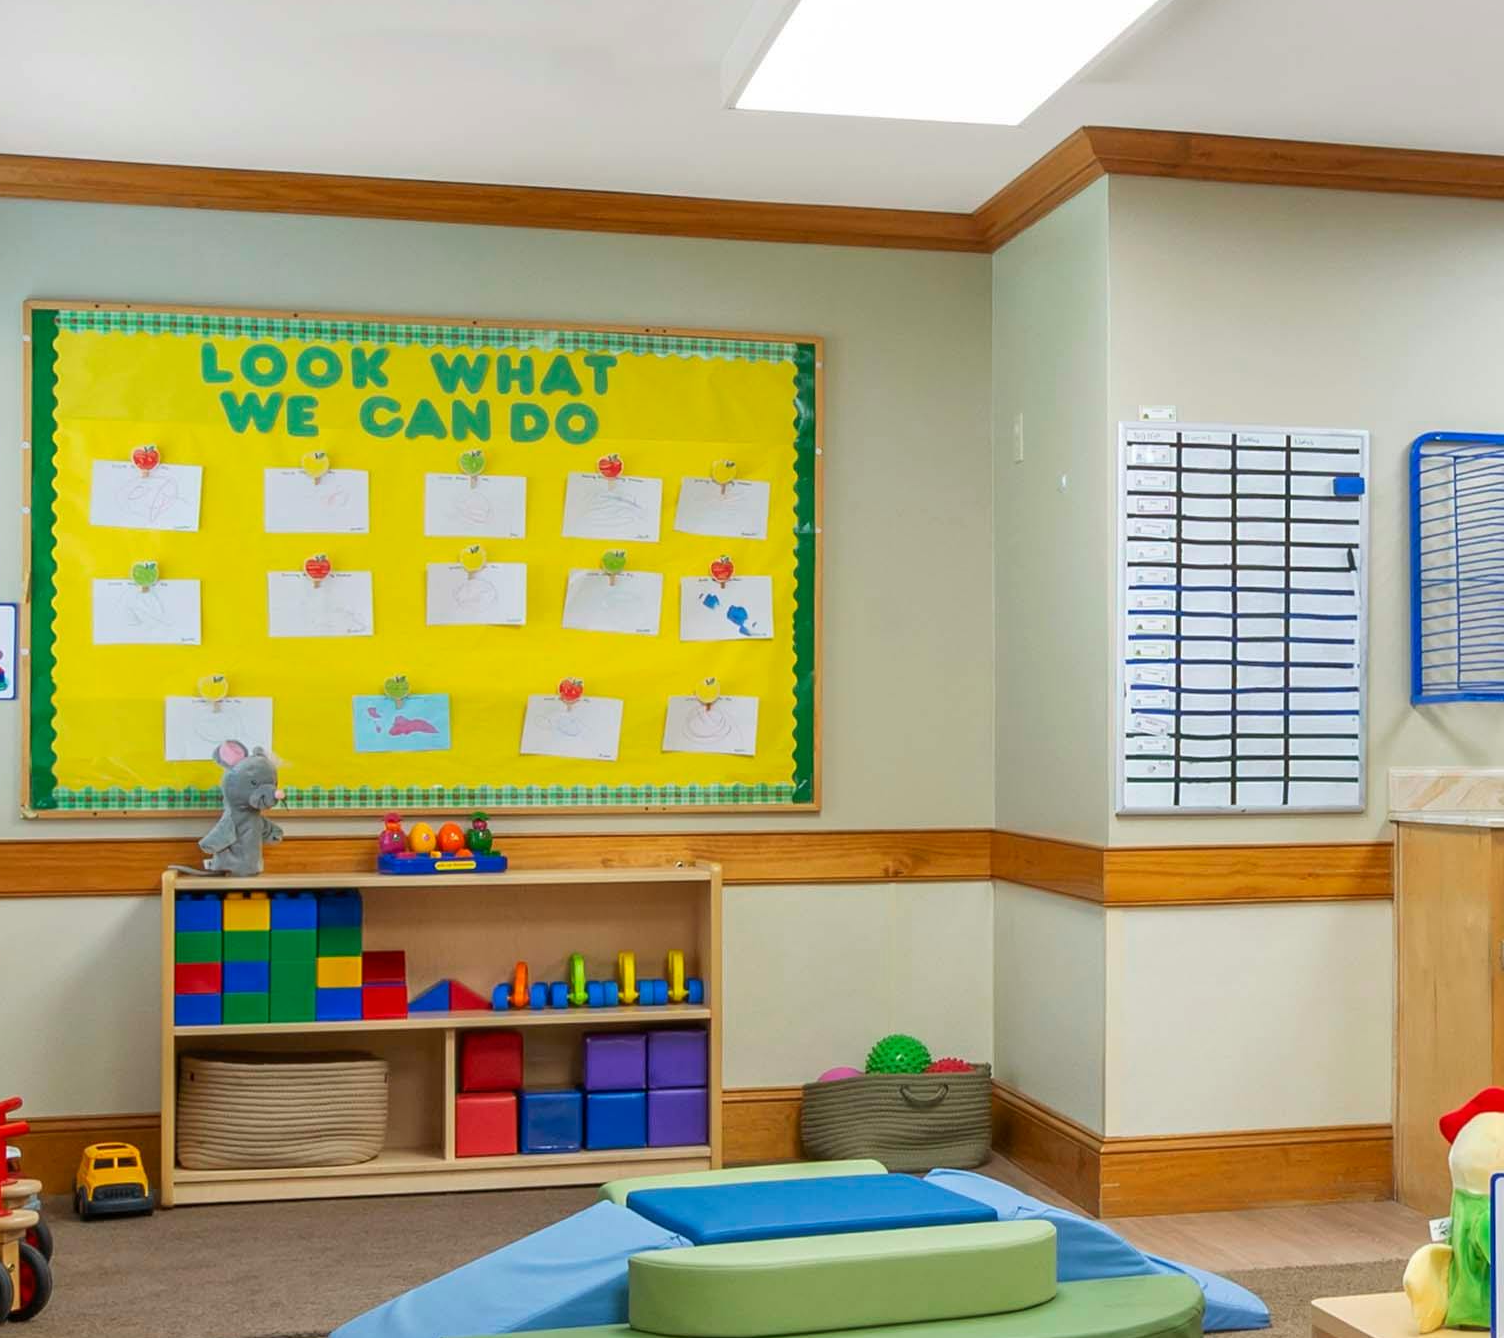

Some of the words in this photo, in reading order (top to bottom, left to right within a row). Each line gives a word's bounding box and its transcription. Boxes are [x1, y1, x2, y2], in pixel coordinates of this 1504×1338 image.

[200, 342, 391, 389] LOOK
[430, 351, 618, 396] WHAT
[219, 390, 319, 437] WE
[359, 396, 492, 442] CAN
[509, 402, 600, 445] DO
